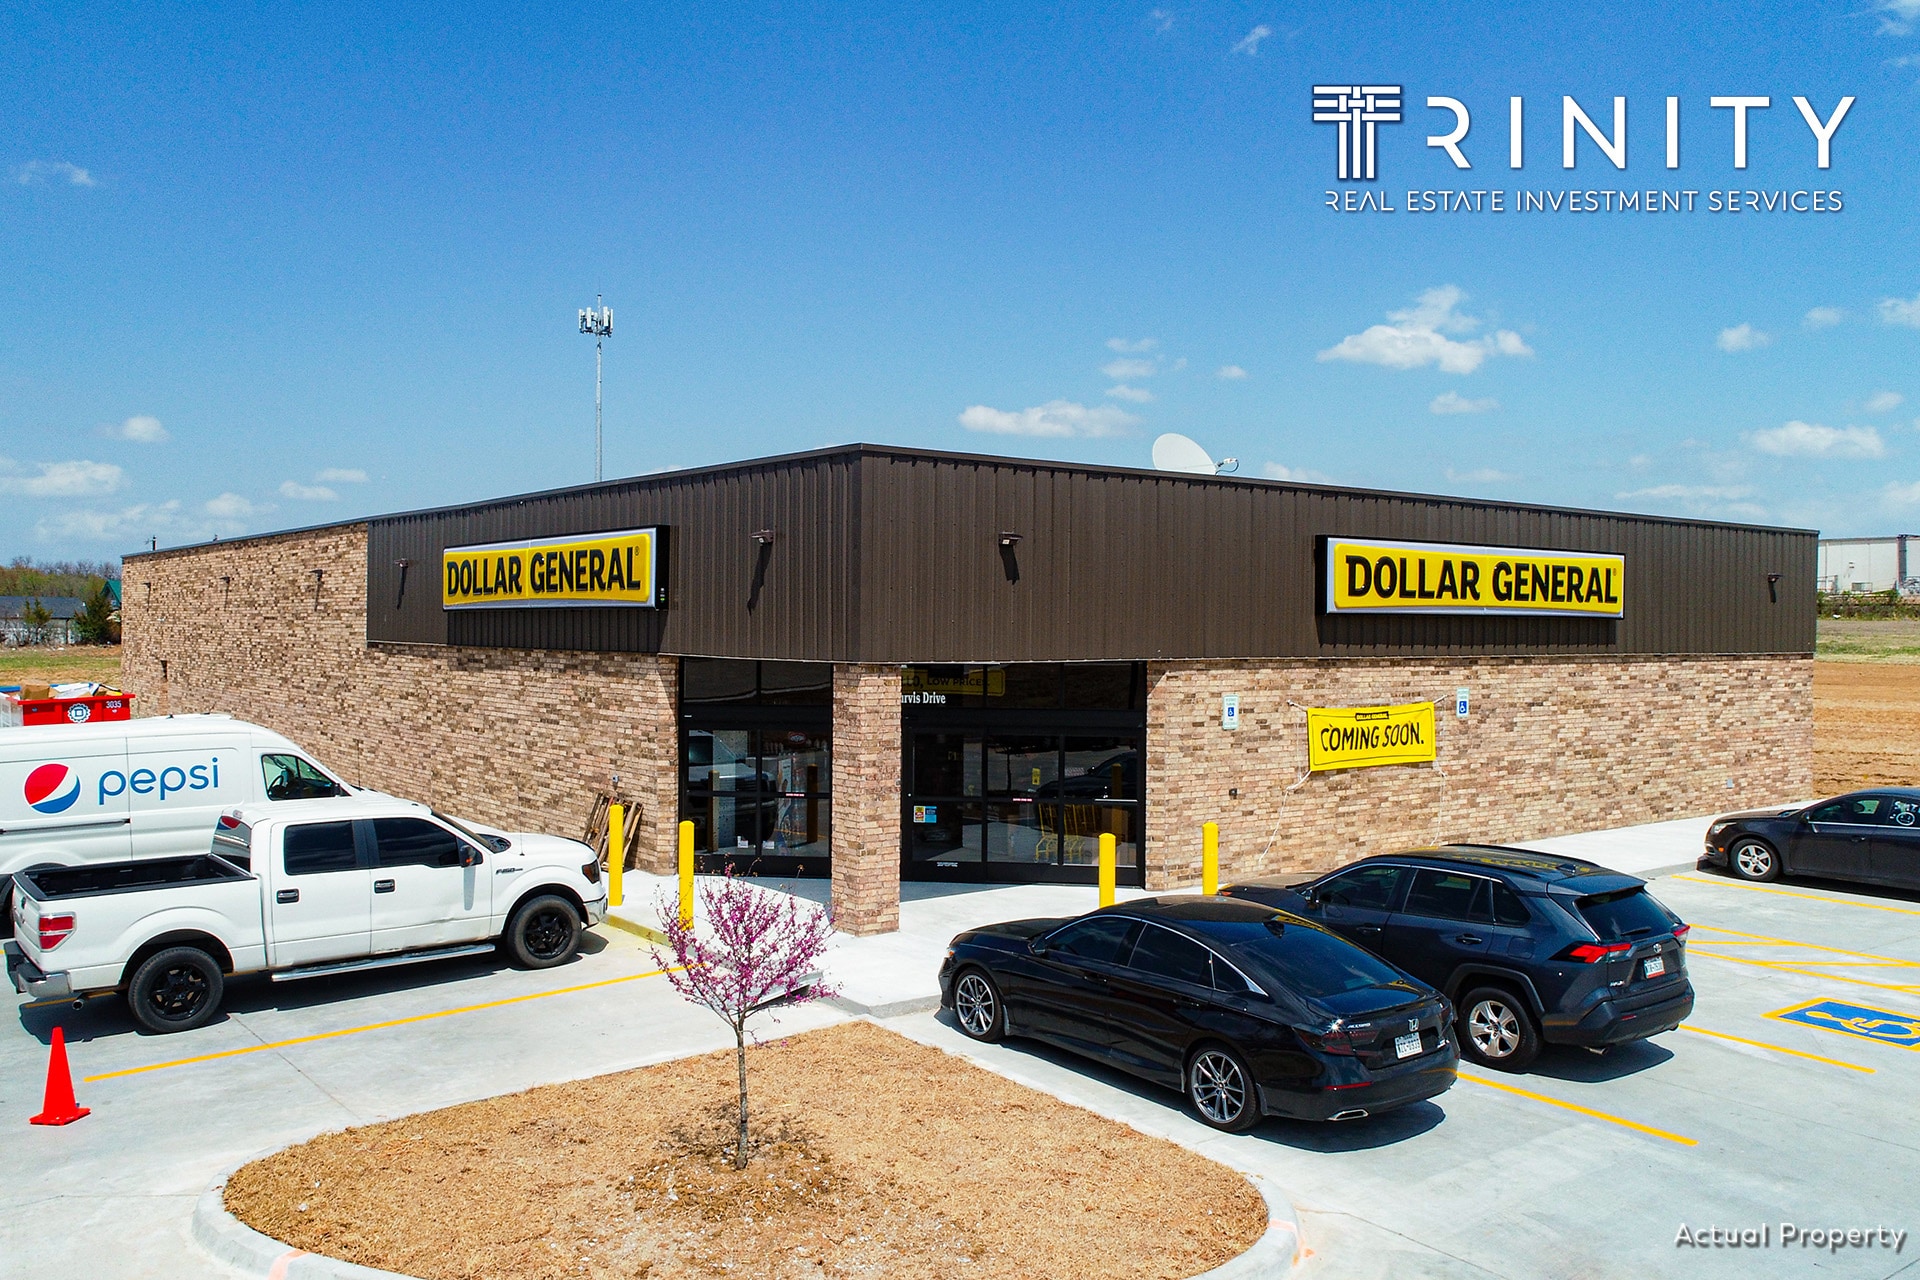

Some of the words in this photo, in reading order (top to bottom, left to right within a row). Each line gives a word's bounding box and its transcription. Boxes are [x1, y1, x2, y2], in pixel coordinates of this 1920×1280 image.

[446, 555, 523, 597] DOLLAR
[530, 546, 642, 594] GENERAL
[1345, 554, 1481, 600] DOLLAR
[1492, 560, 1618, 605] GENERAL
[922, 691, 947, 704] Drive
[1320, 726, 1380, 752] COMING
[1382, 721, 1425, 748] SOON.
[98, 756, 219, 806] pepsi
